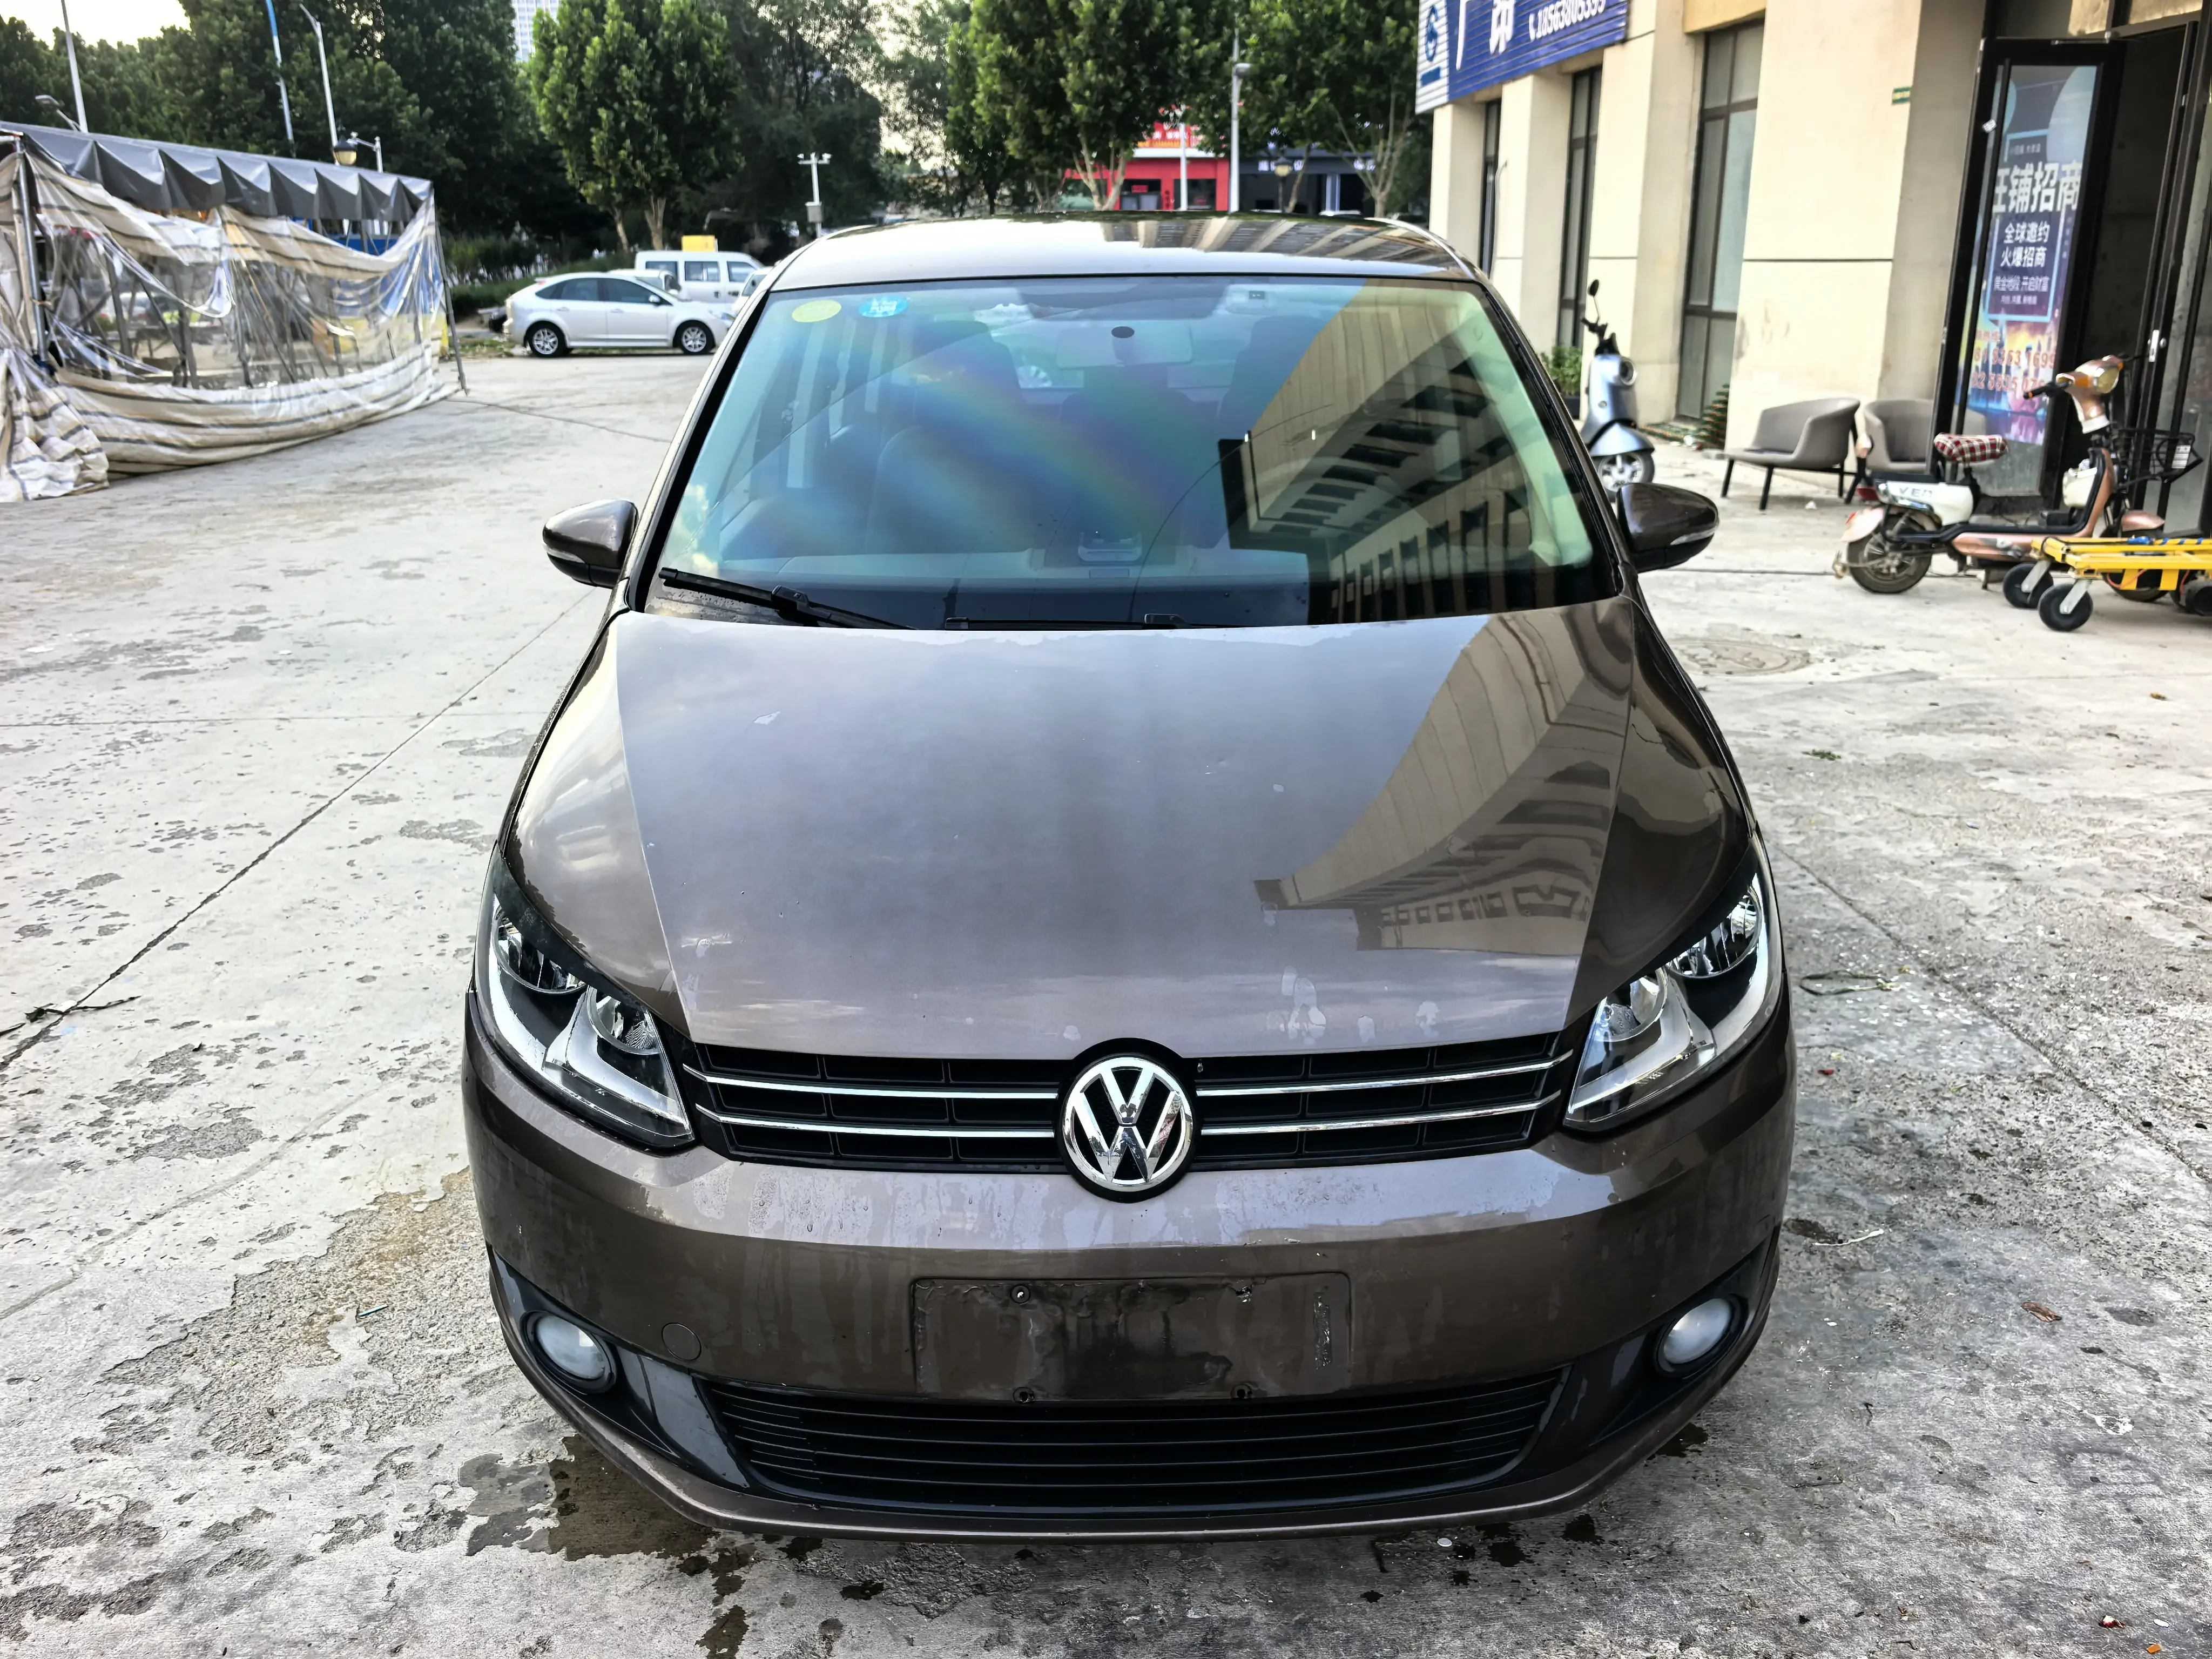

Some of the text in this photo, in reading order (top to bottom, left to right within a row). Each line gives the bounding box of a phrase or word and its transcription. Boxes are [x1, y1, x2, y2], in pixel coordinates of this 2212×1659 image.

[2003, 221, 2051, 243] 全球邀约
[2000, 246, 2047, 268] 火爆招商
